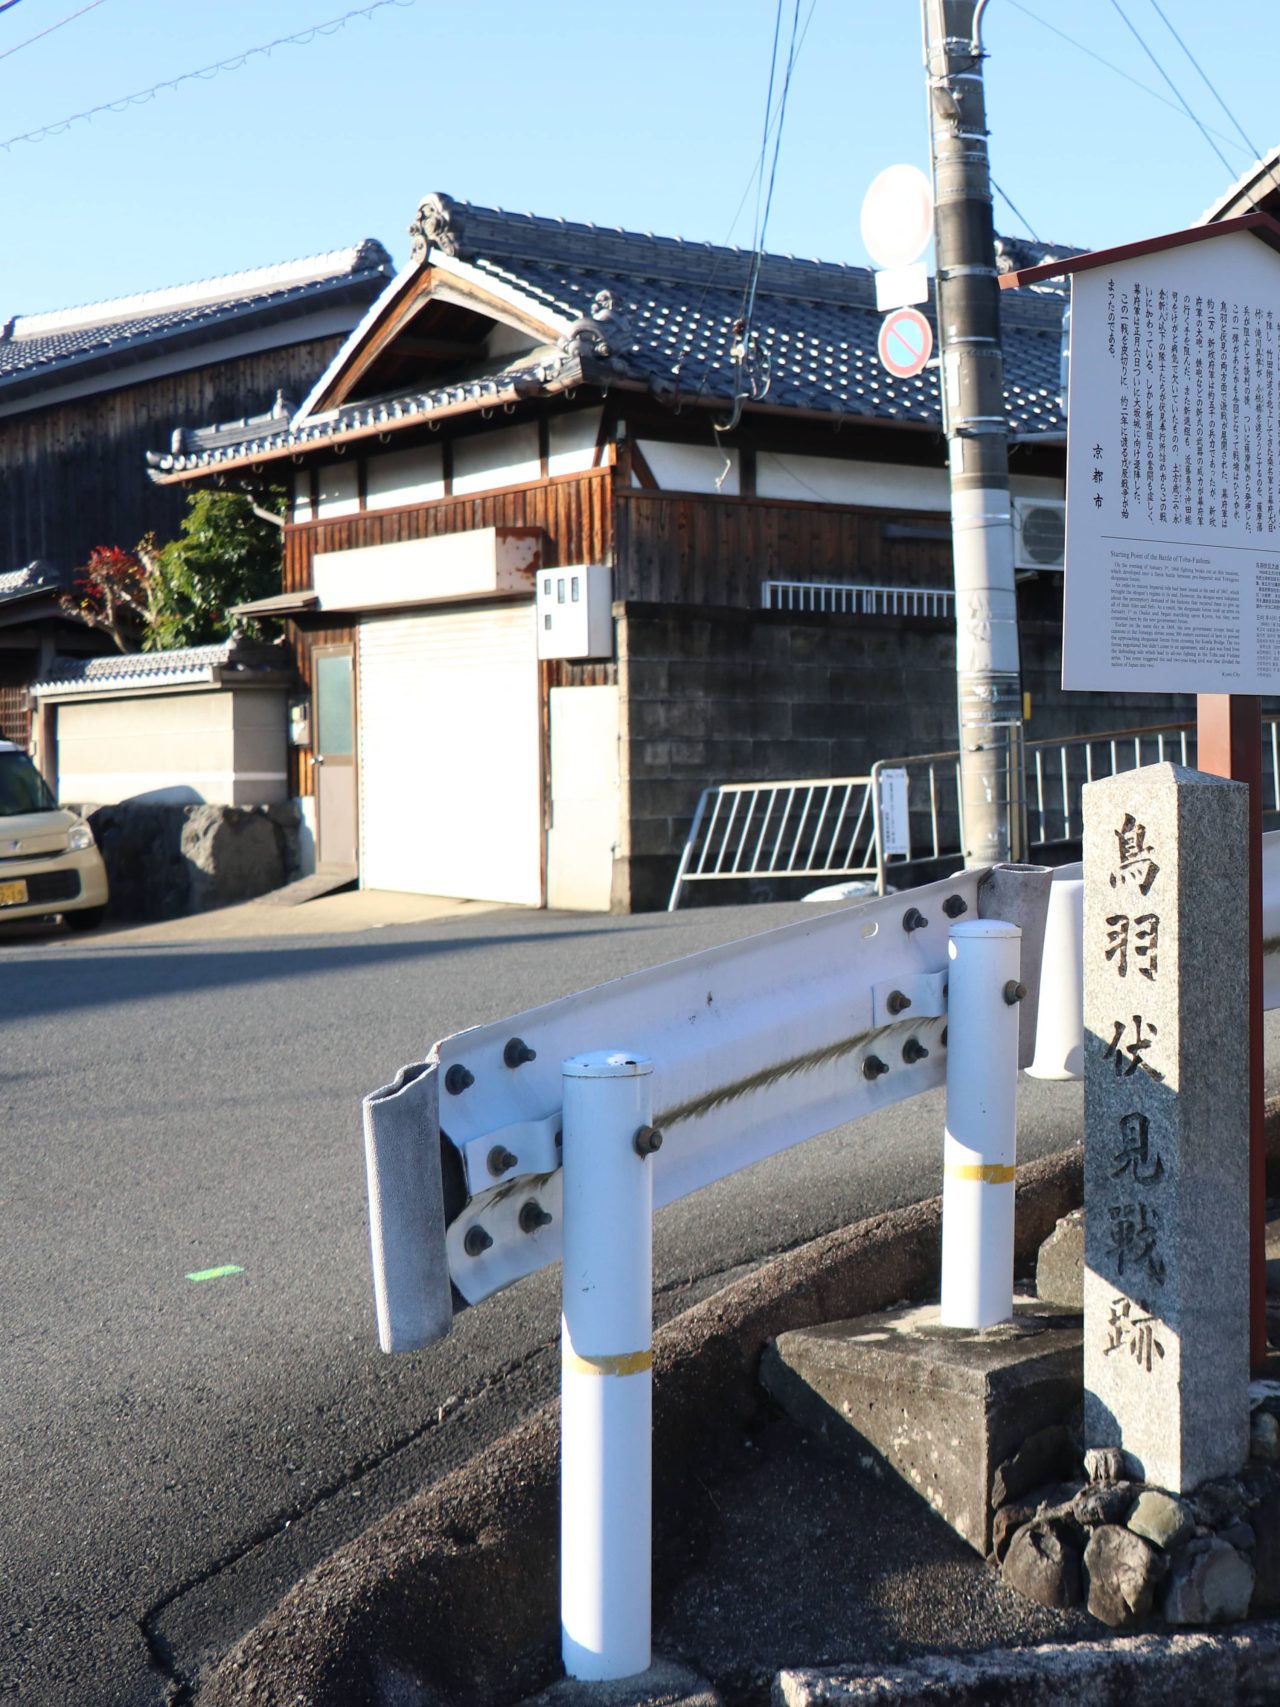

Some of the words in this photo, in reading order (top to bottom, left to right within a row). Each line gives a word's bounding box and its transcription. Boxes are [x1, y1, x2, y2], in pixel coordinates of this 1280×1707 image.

[1107, 278, 1116, 359] まったのである。
[1091, 443, 1104, 511] 京都市
